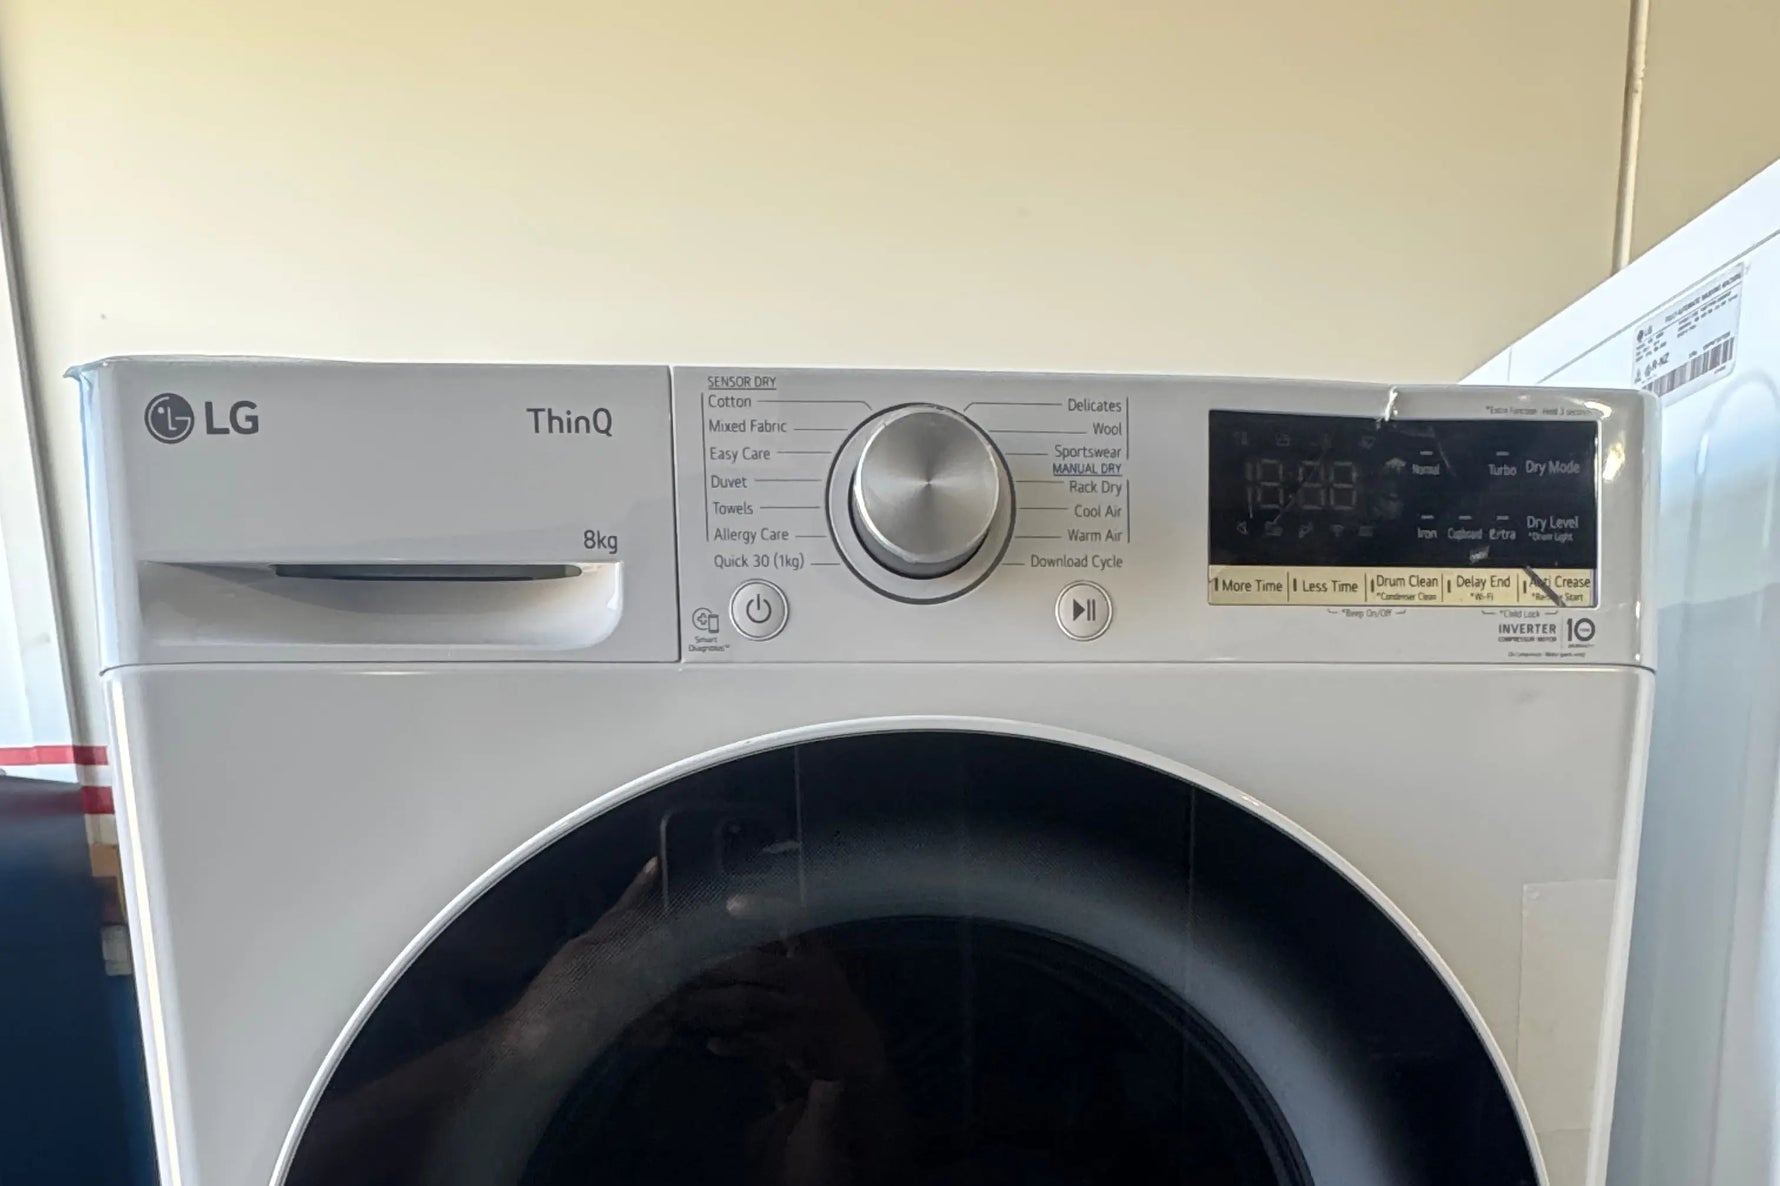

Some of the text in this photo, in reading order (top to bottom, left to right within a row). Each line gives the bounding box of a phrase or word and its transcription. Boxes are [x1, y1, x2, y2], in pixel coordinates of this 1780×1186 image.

[707, 376, 777, 388] SENSOR DRY
[708, 394, 752, 408] Cotton
[1067, 398, 1122, 412] Delicates
[204, 400, 259, 435] LG
[526, 407, 613, 437] ThinQ
[708, 419, 787, 433] Mixed Fabric
[1092, 422, 1122, 436] Wool
[710, 447, 771, 463] Easy Care
[1054, 445, 1122, 461] Sportswear
[1053, 463, 1122, 475] MANUAL DRY
[1412, 460, 1580, 477] Normal Turbo Dry Mode
[711, 475, 748, 489] Duvet
[1069, 480, 1122, 496] Rack Dry
[713, 502, 754, 515] Towels
[1074, 504, 1122, 518] Cool Air
[1417, 528, 1438, 539] Iron
[1526, 515, 1547, 532] Dry
[1550, 515, 1579, 529] Level
[583, 529, 618, 554] 8kg
[714, 528, 789, 544] Allergy Care
[1067, 529, 1123, 542] Warm Air
[714, 553, 805, 570] Quick 30 (1kg)
[1030, 555, 1123, 571] Download Cycle
[1222, 579, 1283, 592] More Time
[1302, 580, 1358, 593] Less Time
[1376, 574, 1439, 588] Drum Clean
[1456, 575, 1511, 590] Delay End
[1554, 575, 1591, 588] Crease
[1564, 592, 1584, 602] Start
[1366, 608, 1393, 618] On/Off
[1498, 623, 1557, 634] INVERTER
[1567, 618, 1596, 642] 10
